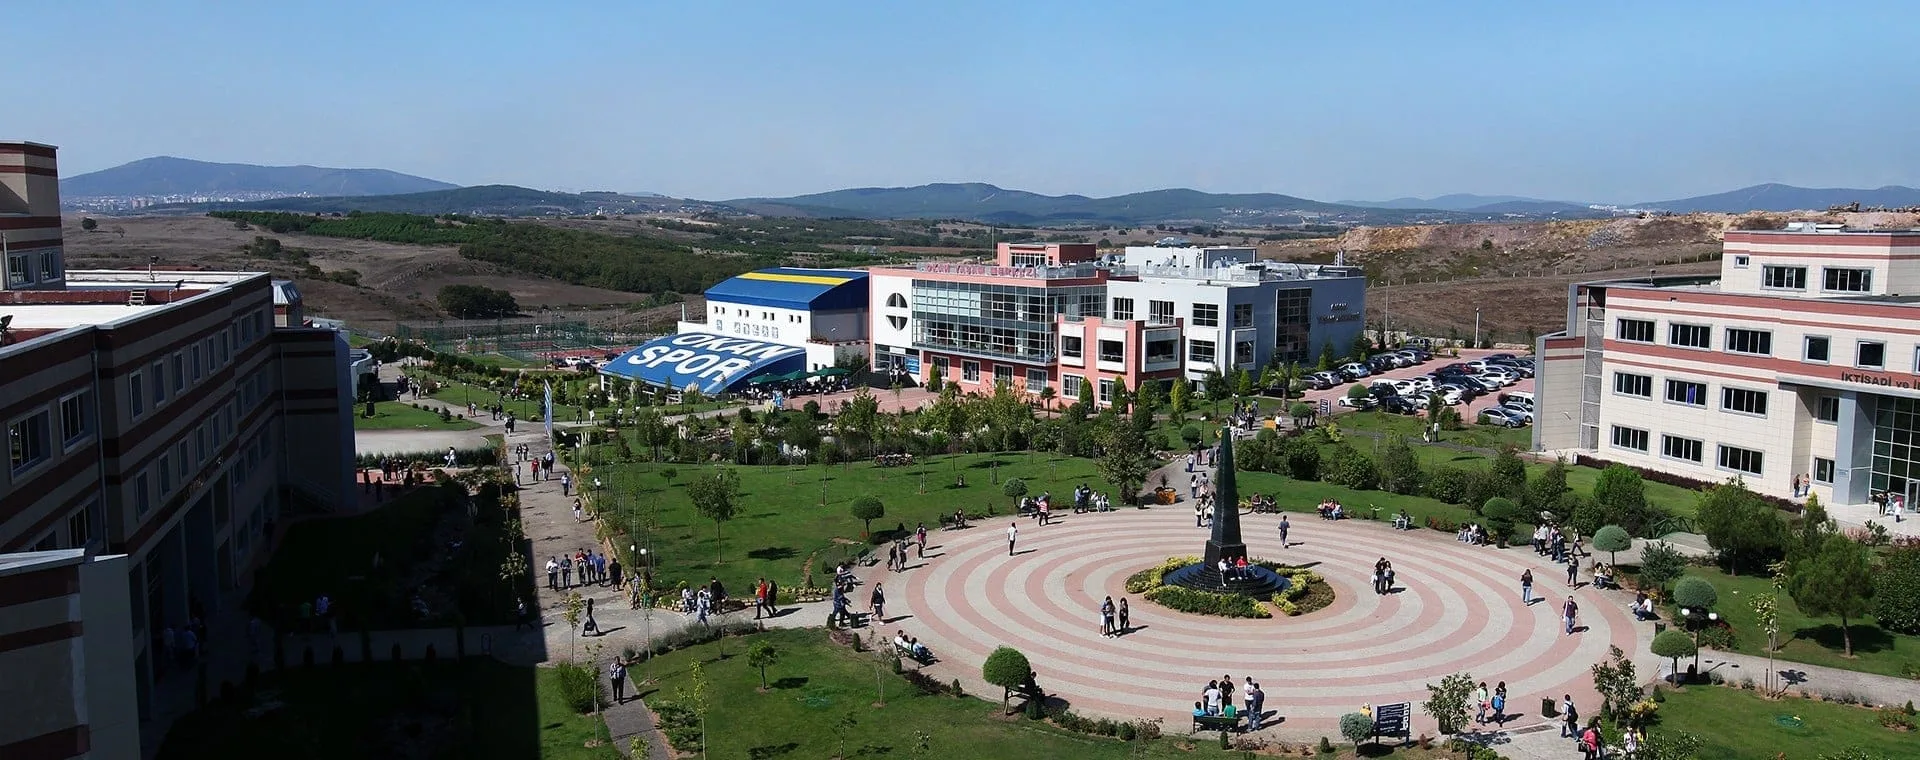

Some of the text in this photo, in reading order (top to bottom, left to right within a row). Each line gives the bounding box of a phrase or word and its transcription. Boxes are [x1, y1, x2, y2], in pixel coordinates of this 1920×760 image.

[671, 334, 797, 360] OKAN
[628, 345, 752, 382] SPOR
[1896, 380, 1910, 389] ve
